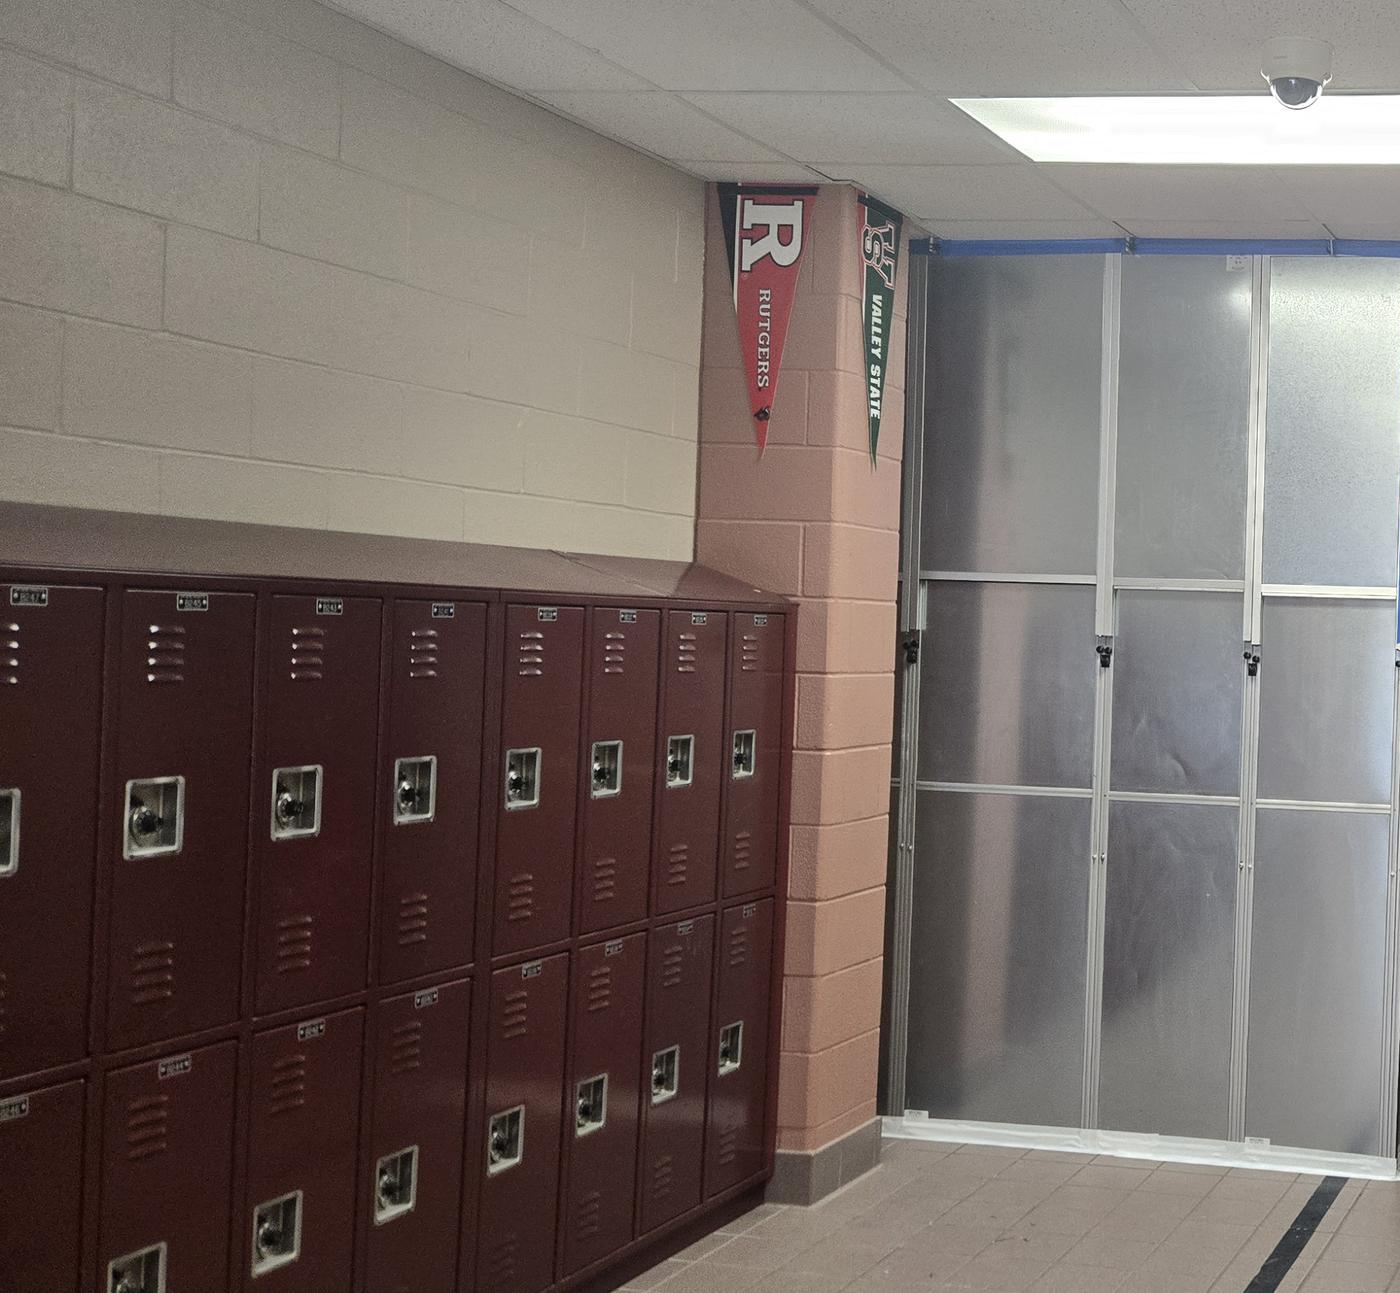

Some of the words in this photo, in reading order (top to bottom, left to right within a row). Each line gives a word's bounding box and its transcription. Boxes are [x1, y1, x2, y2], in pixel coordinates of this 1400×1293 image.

[742, 199, 804, 272] R
[756, 288, 773, 390] RUTGERS
[865, 294, 884, 359] VALLEY
[869, 364, 882, 420] STATE
